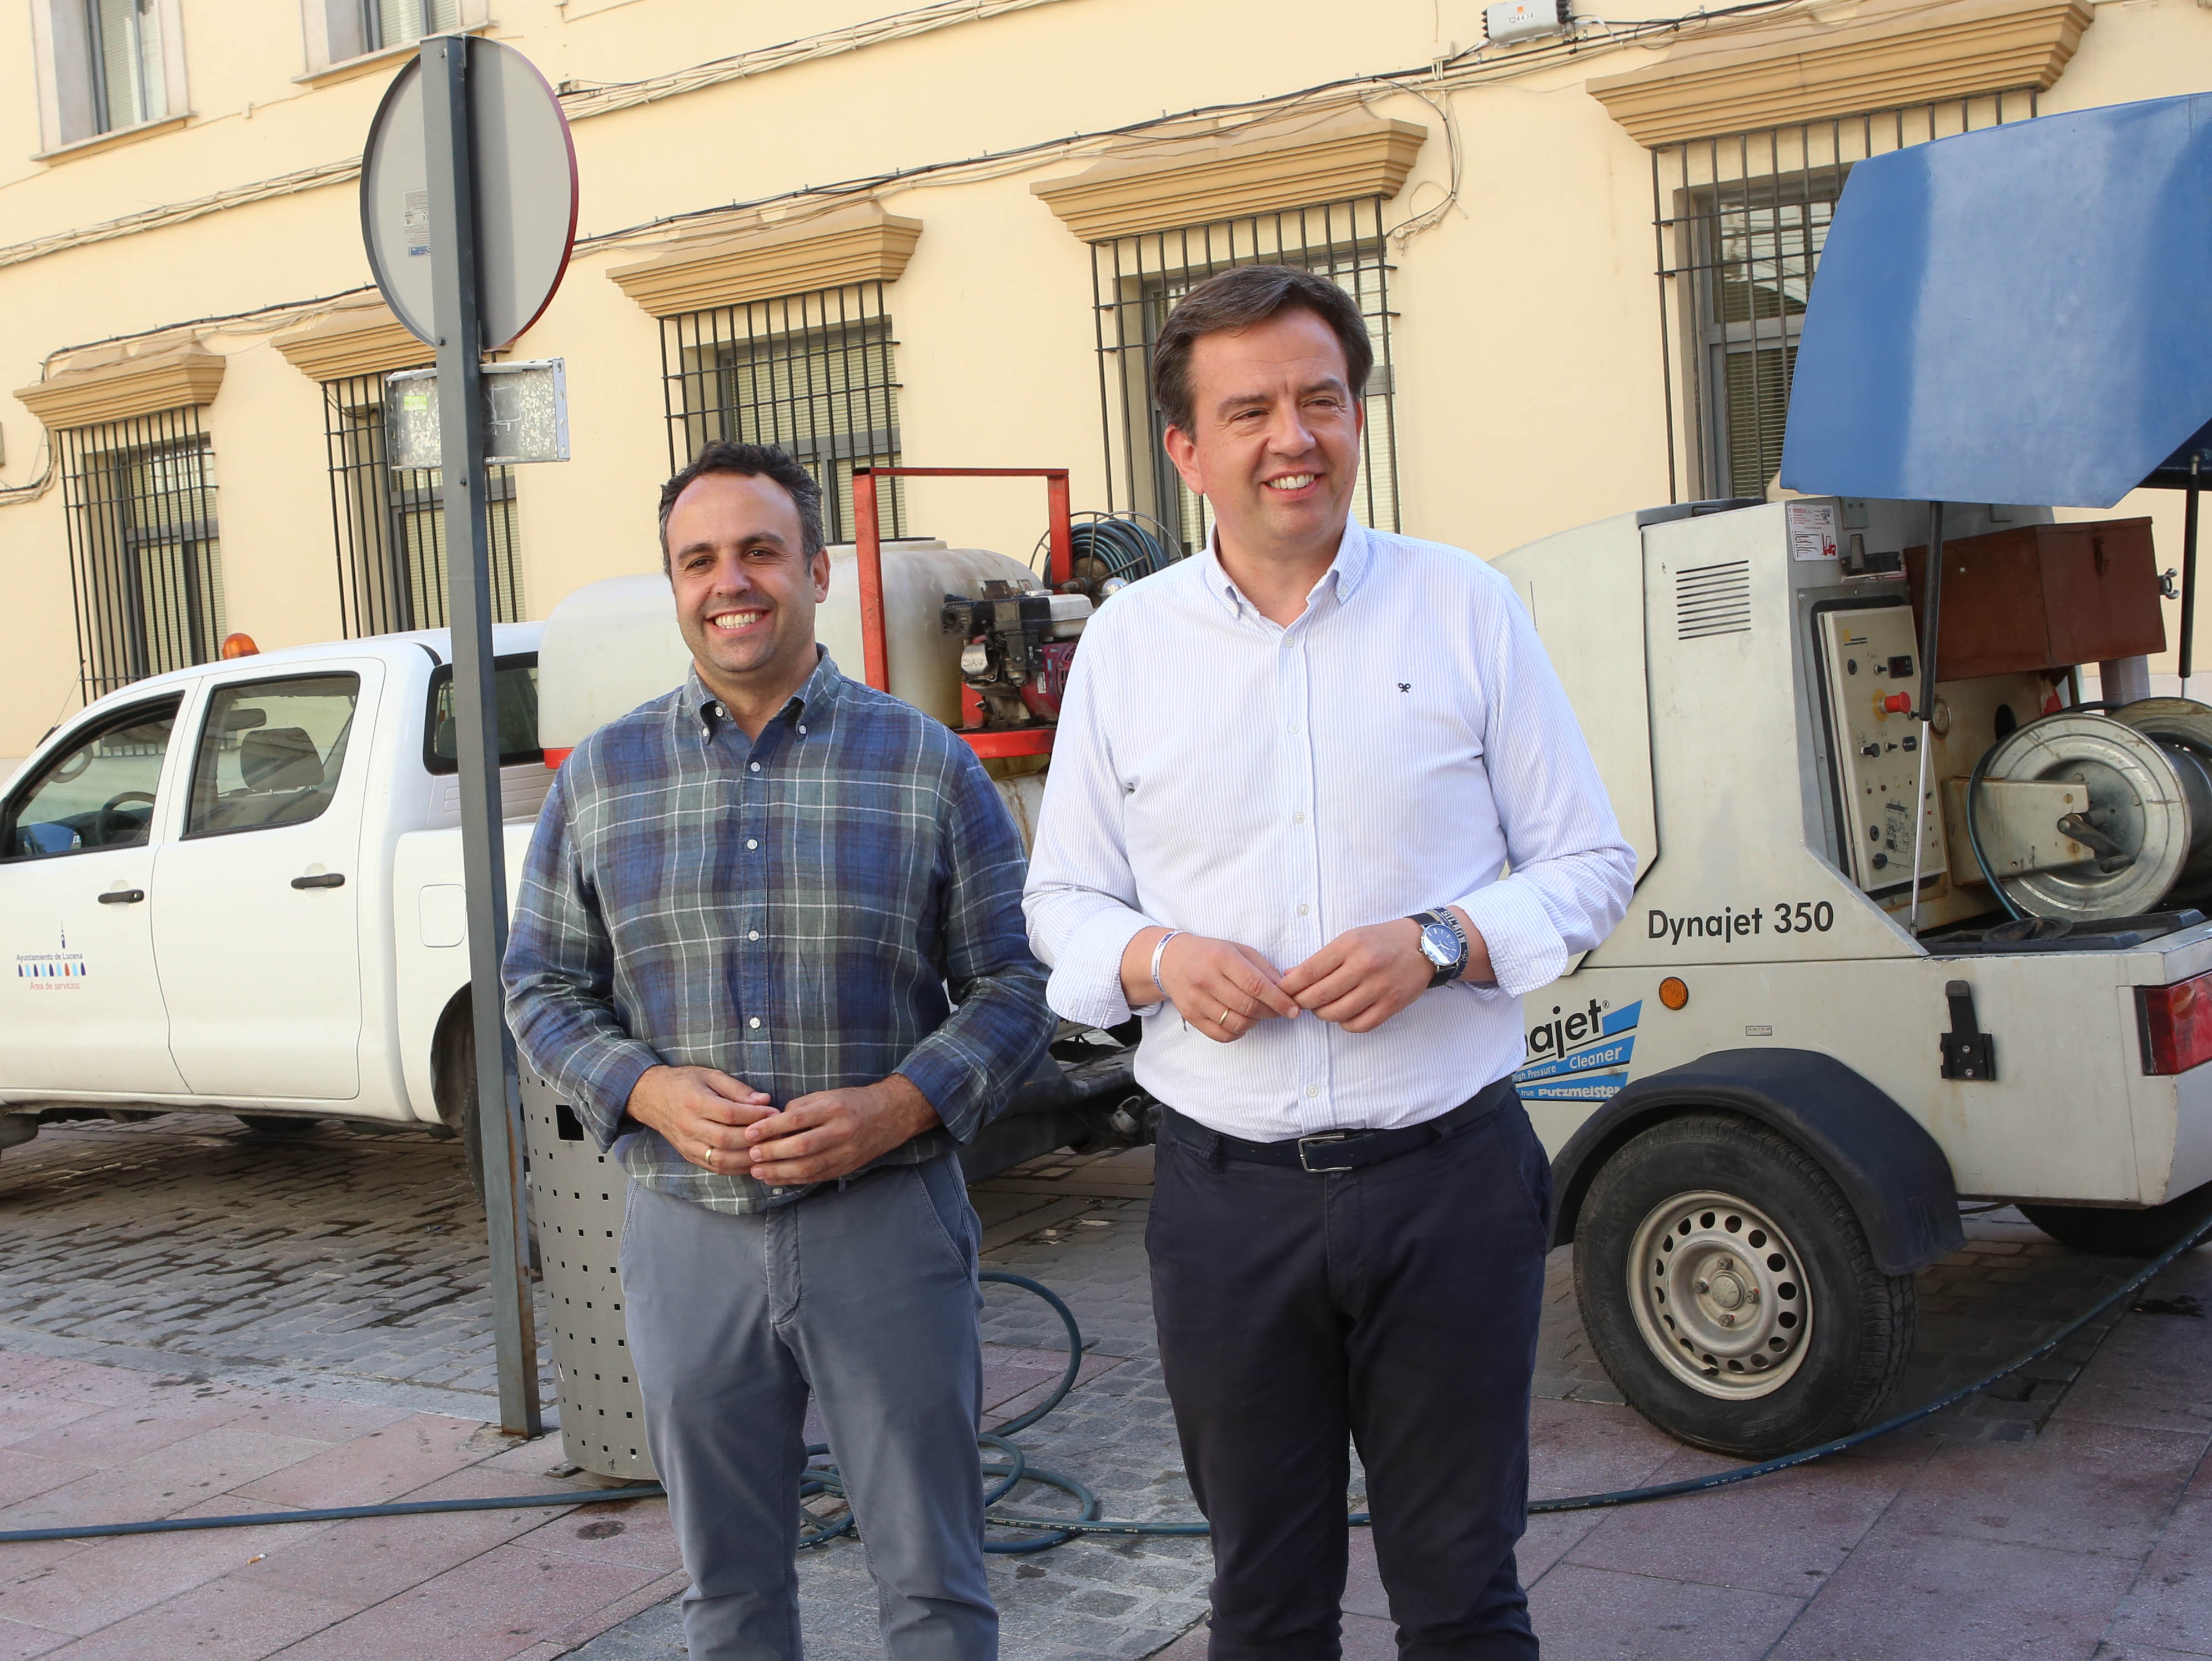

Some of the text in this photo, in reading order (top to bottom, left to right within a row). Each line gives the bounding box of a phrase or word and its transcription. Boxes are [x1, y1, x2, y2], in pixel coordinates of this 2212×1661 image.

[1648, 900, 1834, 945] Dynajet 350
[1527, 1064, 1557, 1079] Pressure
[1569, 1046, 1622, 1069] Cleaner
